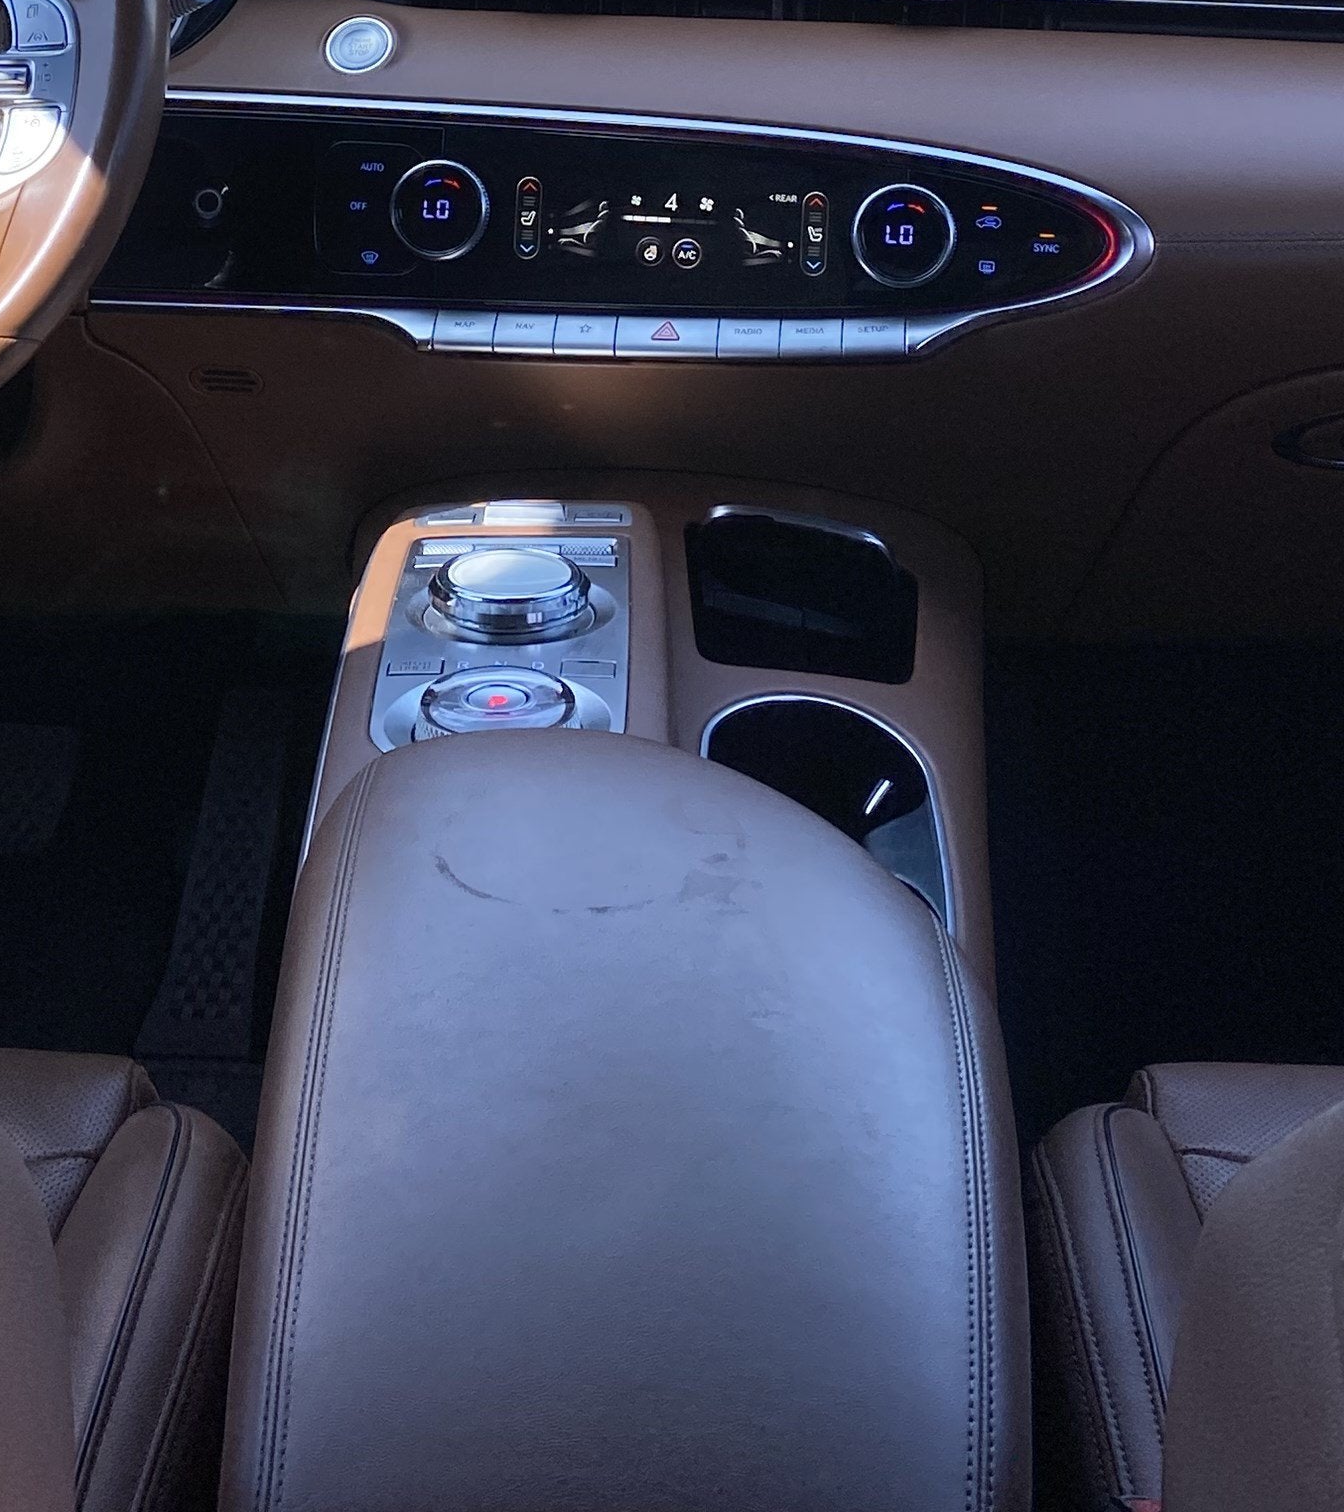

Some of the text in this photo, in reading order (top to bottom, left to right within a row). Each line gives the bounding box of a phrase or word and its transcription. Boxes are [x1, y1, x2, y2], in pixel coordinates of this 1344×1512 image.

[359, 161, 385, 173] AUTO
[664, 192, 679, 212] 4
[775, 193, 798, 204] REAR
[349, 200, 368, 212] OFF
[422, 198, 450, 221] LO
[885, 224, 914, 245] LO
[1033, 242, 1060, 255] SYNC
[677, 248, 697, 262] A/C
[454, 319, 476, 329] MAP
[514, 320, 536, 330] NAV
[856, 324, 890, 335] SETUP
[733, 326, 764, 337] RADIO
[794, 326, 825, 336] MEDIA
[487, 694, 509, 708] P
